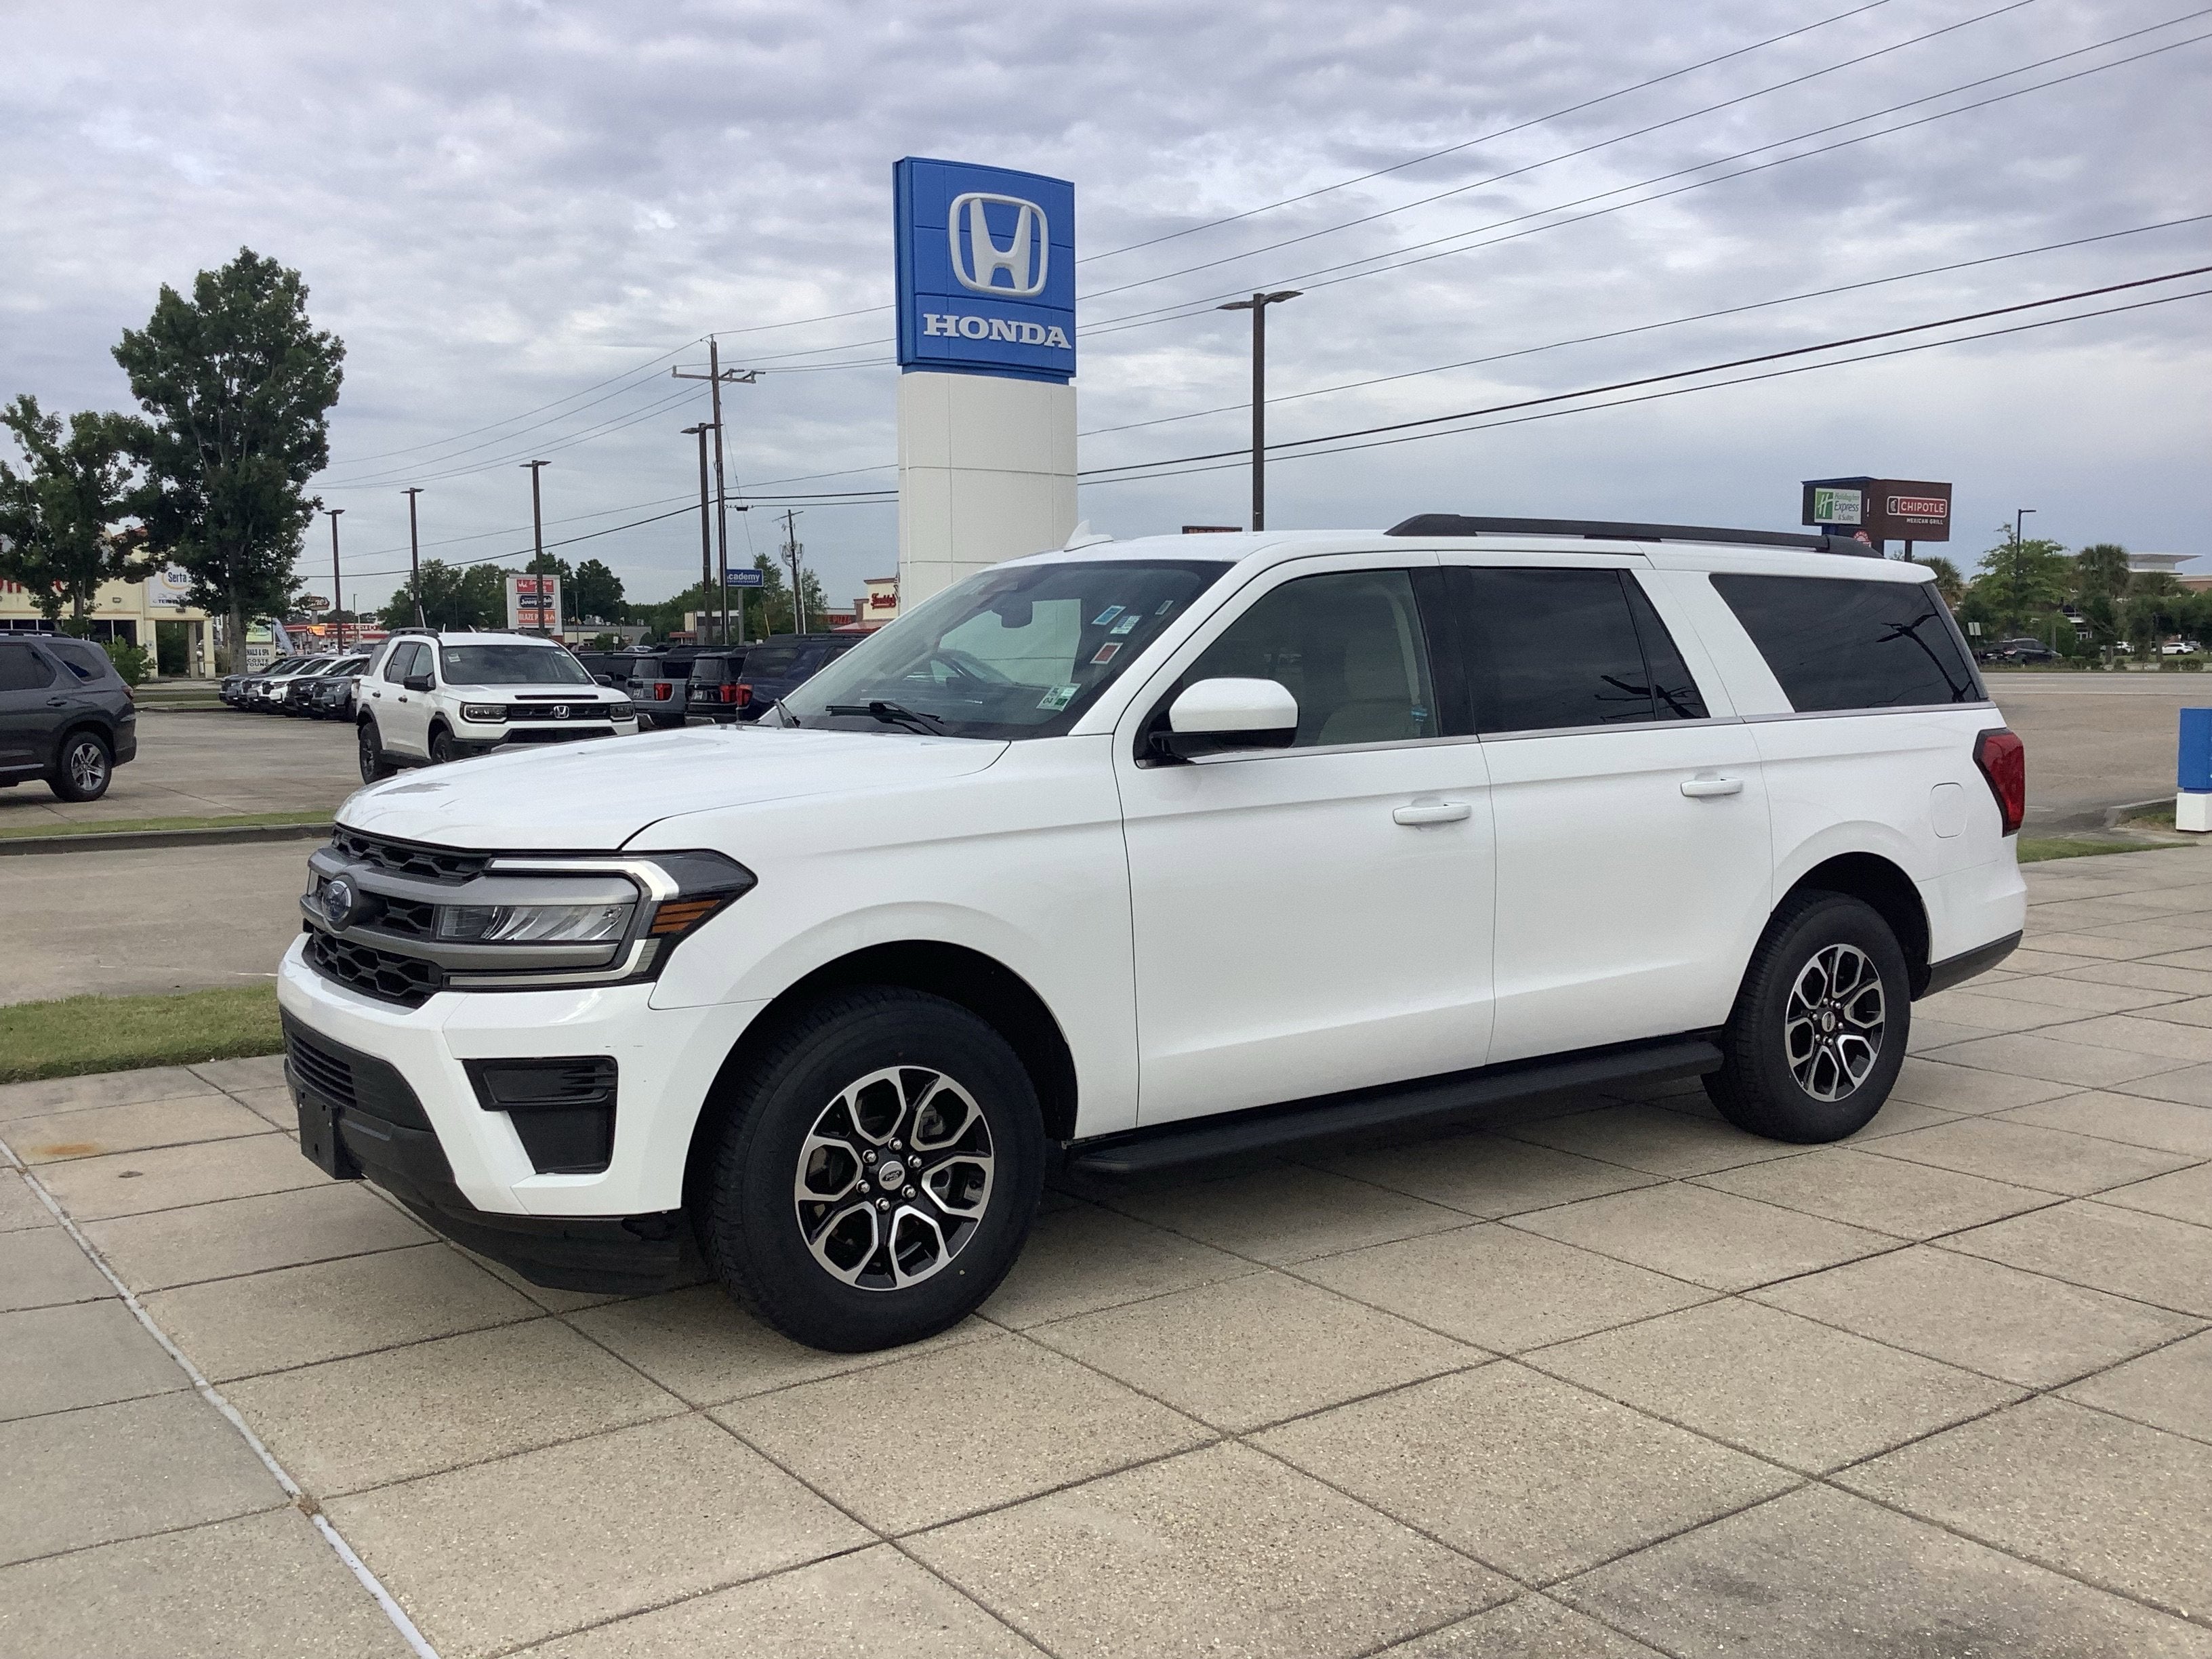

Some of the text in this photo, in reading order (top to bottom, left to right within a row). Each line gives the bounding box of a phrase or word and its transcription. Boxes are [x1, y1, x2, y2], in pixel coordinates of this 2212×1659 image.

[923, 313, 1072, 350] HONDA
[1834, 500, 1860, 513] Express
[1900, 501, 1945, 513] CHIPOTLE
[167, 571, 187, 583] Serta
[726, 572, 760, 582] cademy
